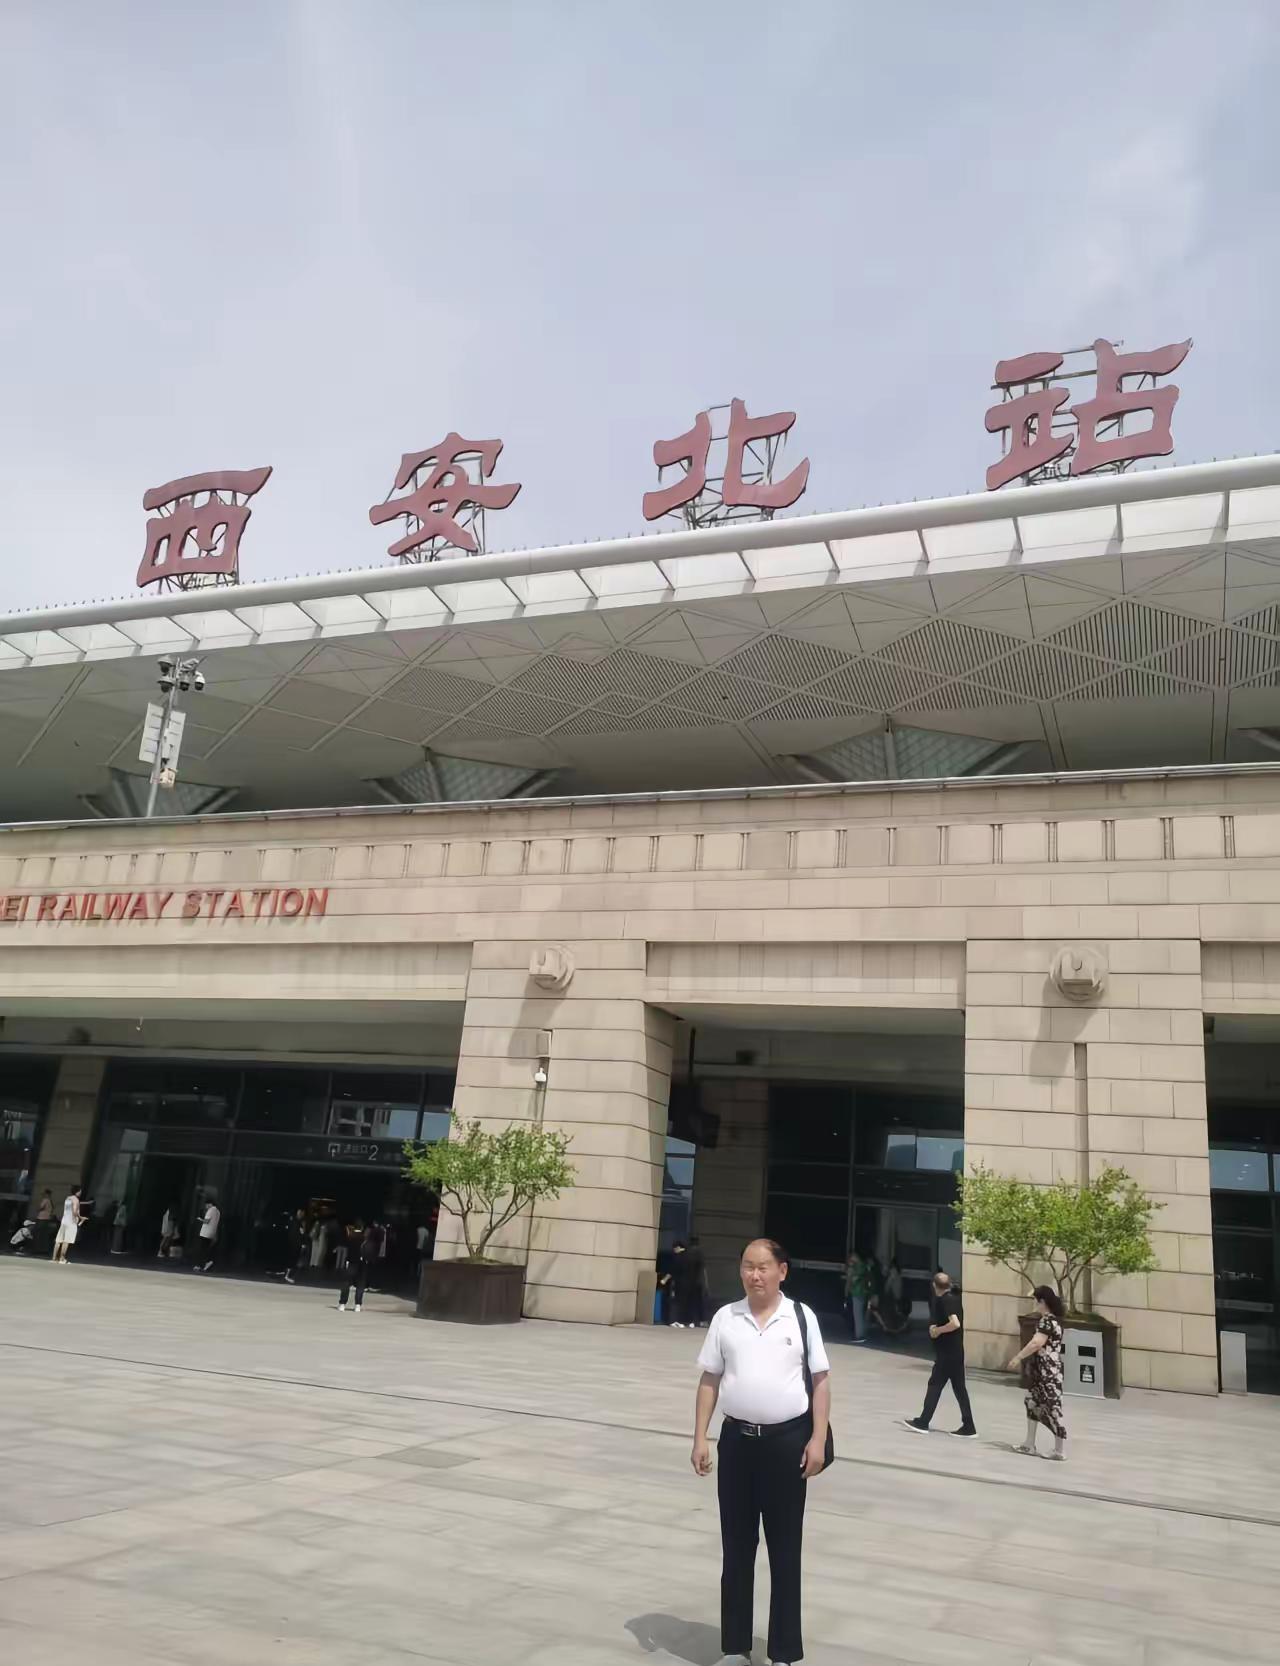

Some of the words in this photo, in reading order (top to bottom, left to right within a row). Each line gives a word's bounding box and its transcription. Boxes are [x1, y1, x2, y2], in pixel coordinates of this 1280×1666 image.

[137, 338, 1192, 588] 西安北站
[0, 895, 30, 921] EI
[37, 892, 173, 921] RAILWAY
[183, 888, 329, 918] STATION
[368, 1144, 379, 1161] 2
